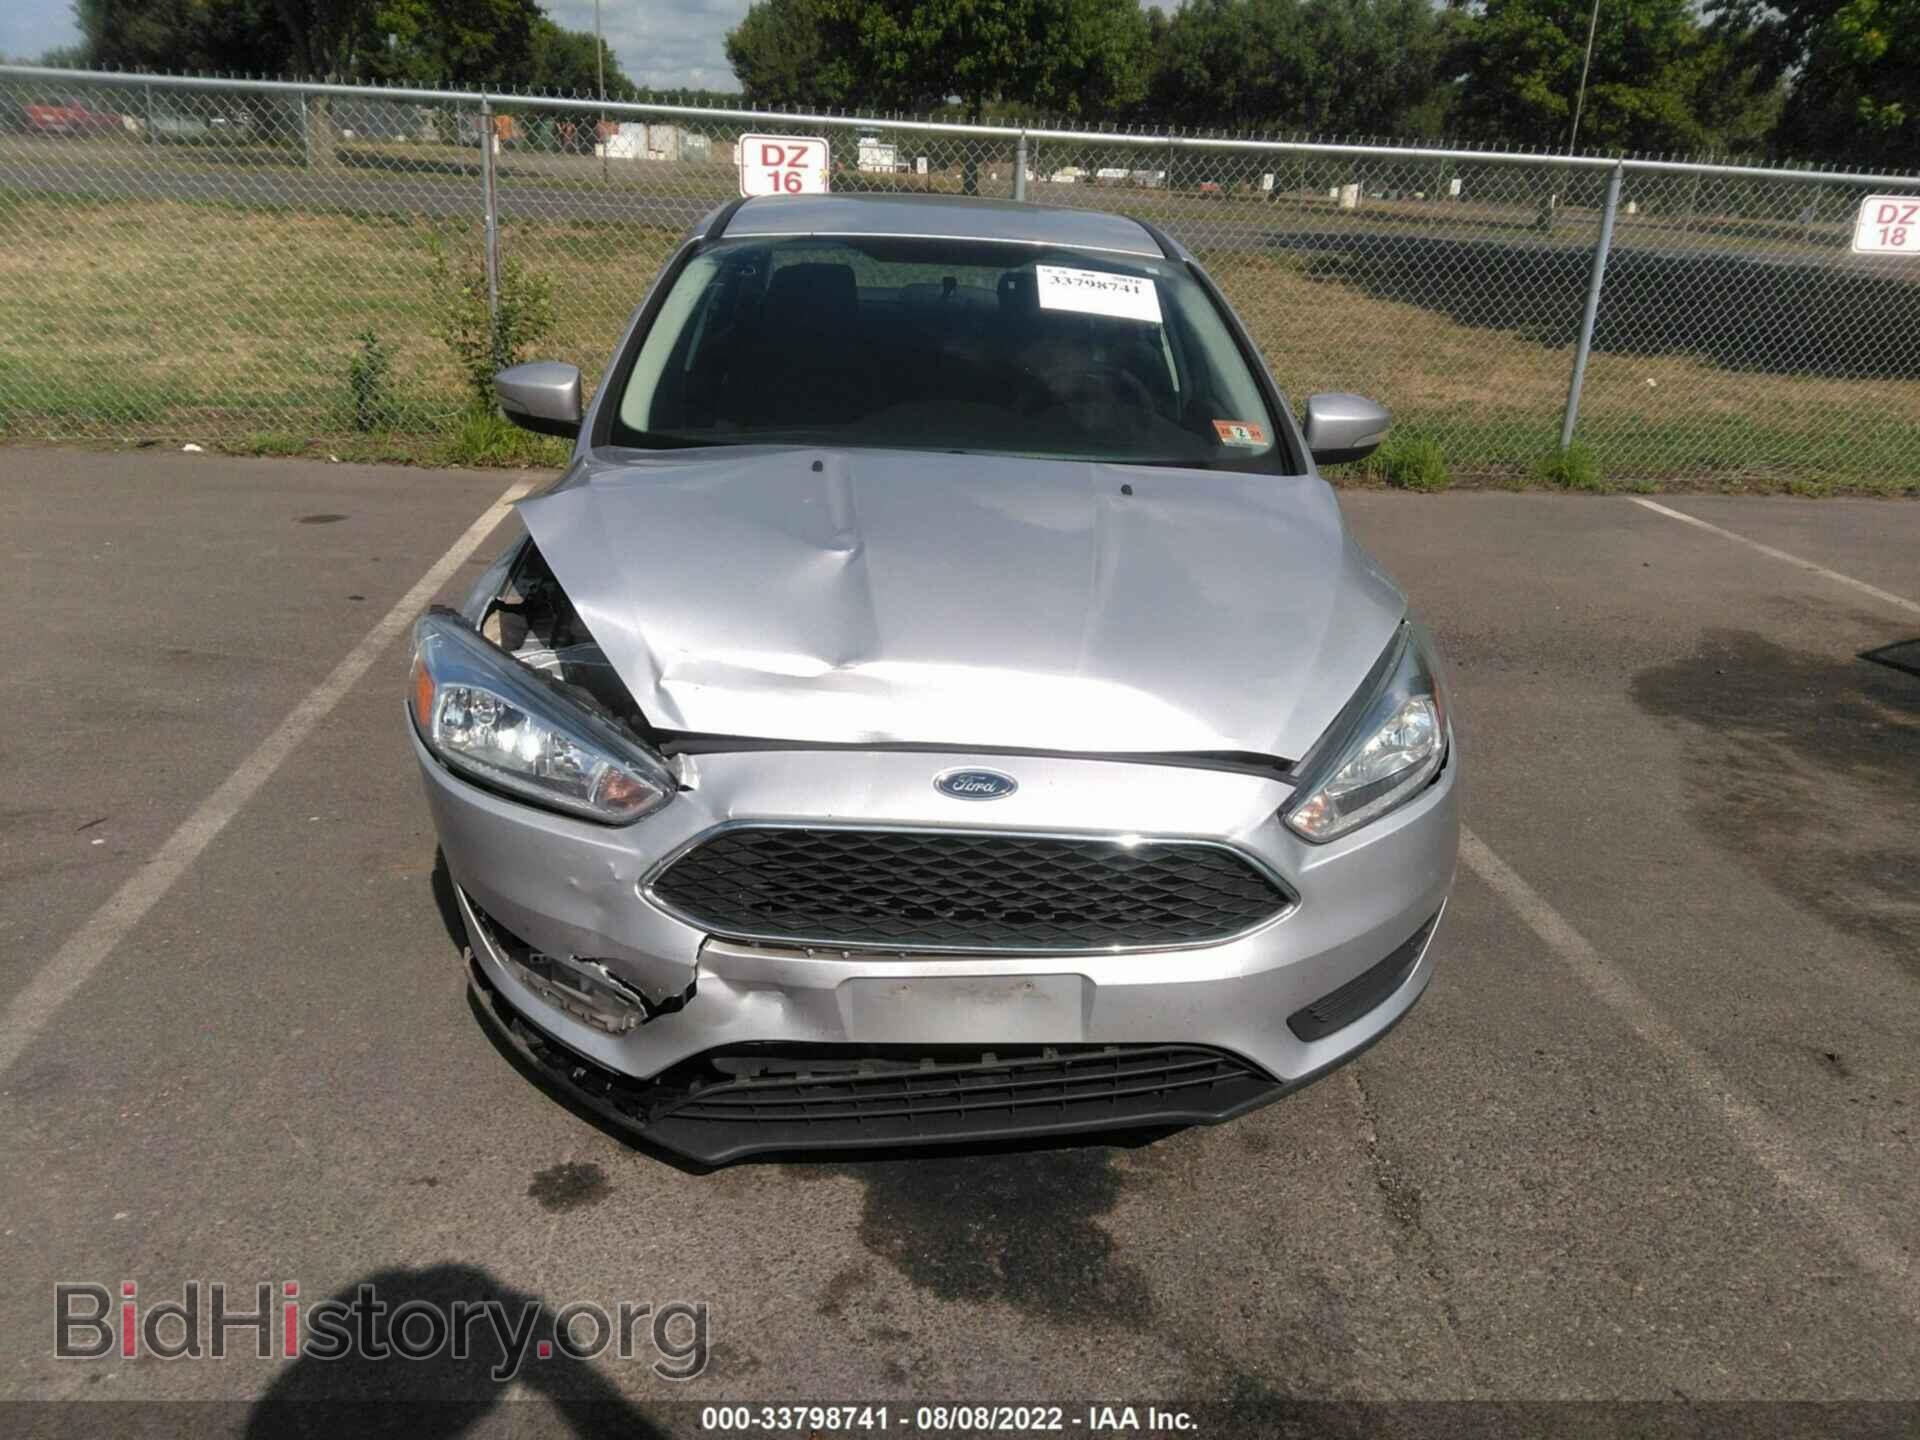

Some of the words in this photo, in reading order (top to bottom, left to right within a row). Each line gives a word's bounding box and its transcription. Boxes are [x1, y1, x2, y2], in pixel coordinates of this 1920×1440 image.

[761, 143, 808, 168] DZ
[767, 170, 802, 193] 16
[1876, 204, 1920, 225] DZ
[1879, 226, 1907, 246] 18
[1049, 275, 1141, 294] 33798741
[952, 774, 998, 792] Ford
